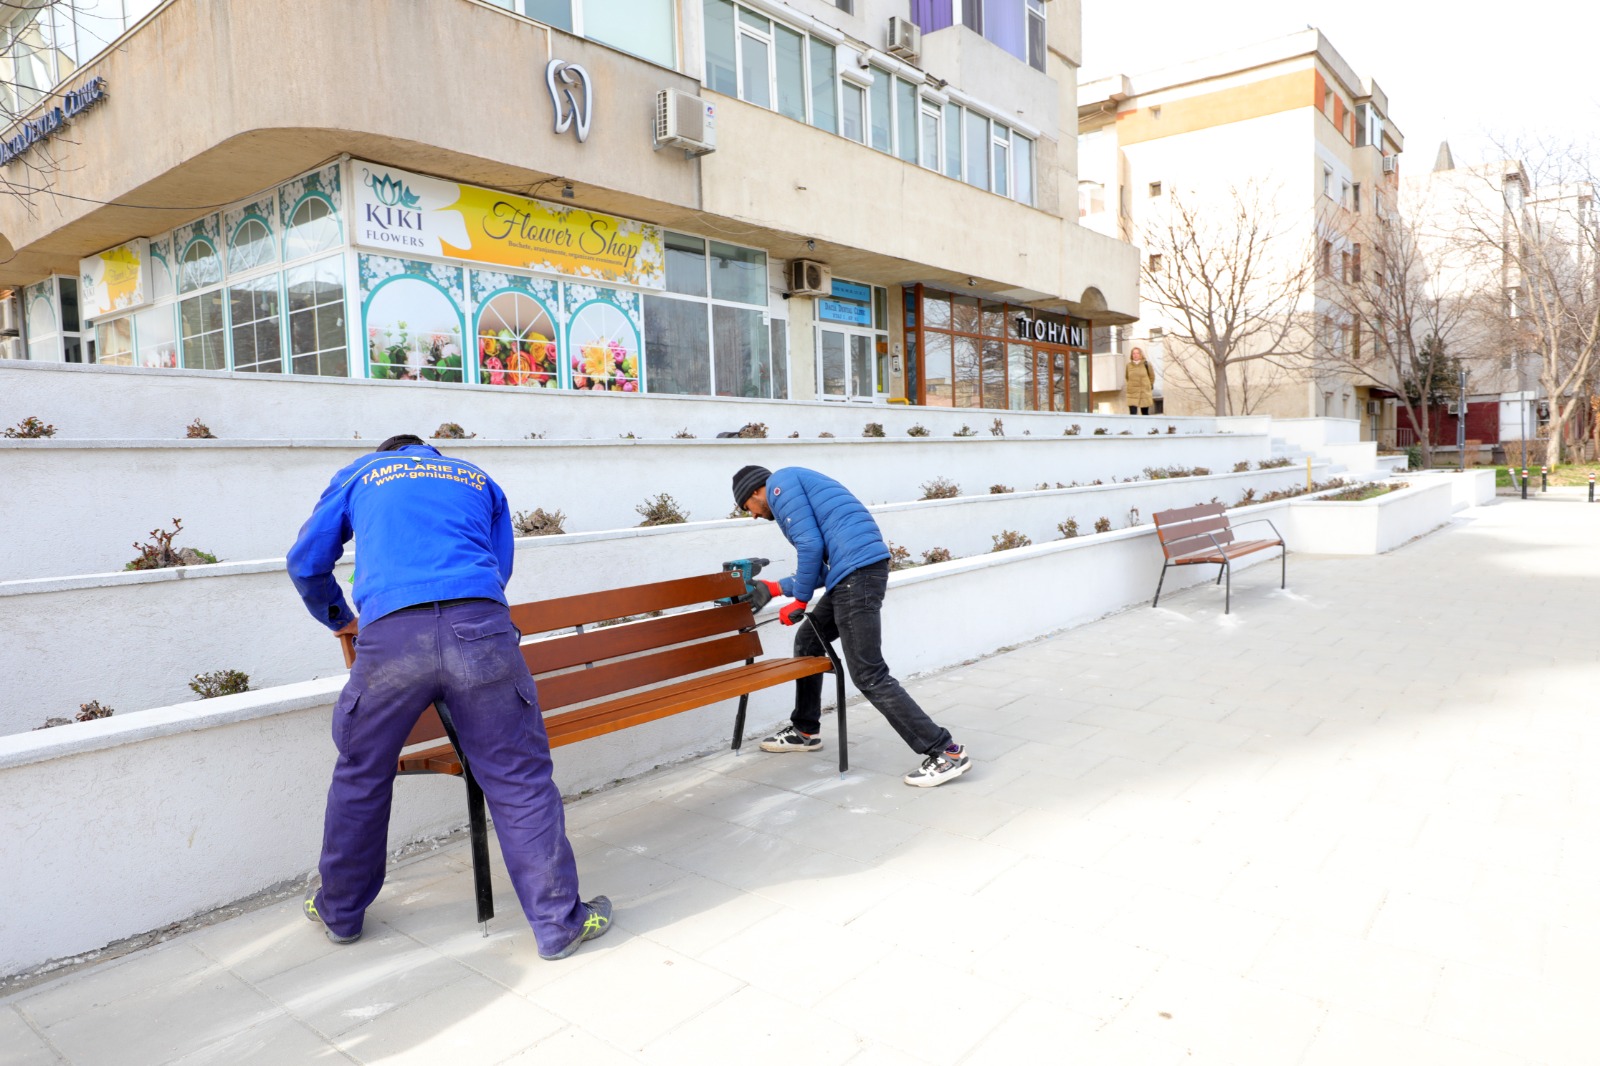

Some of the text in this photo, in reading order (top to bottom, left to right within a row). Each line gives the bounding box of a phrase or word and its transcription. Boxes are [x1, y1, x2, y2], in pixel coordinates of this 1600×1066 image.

[24, 107, 62, 143] DENTAL
[64, 77, 104, 118] CLINIC
[365, 203, 422, 231] KIKI
[366, 229, 425, 247] FLOWERS
[482, 201, 638, 268] Flower Shop
[1021, 317, 1085, 346] TOHANI
[375, 471, 483, 491] www.geniussrl.ro
[457, 467, 486, 486] PVC
